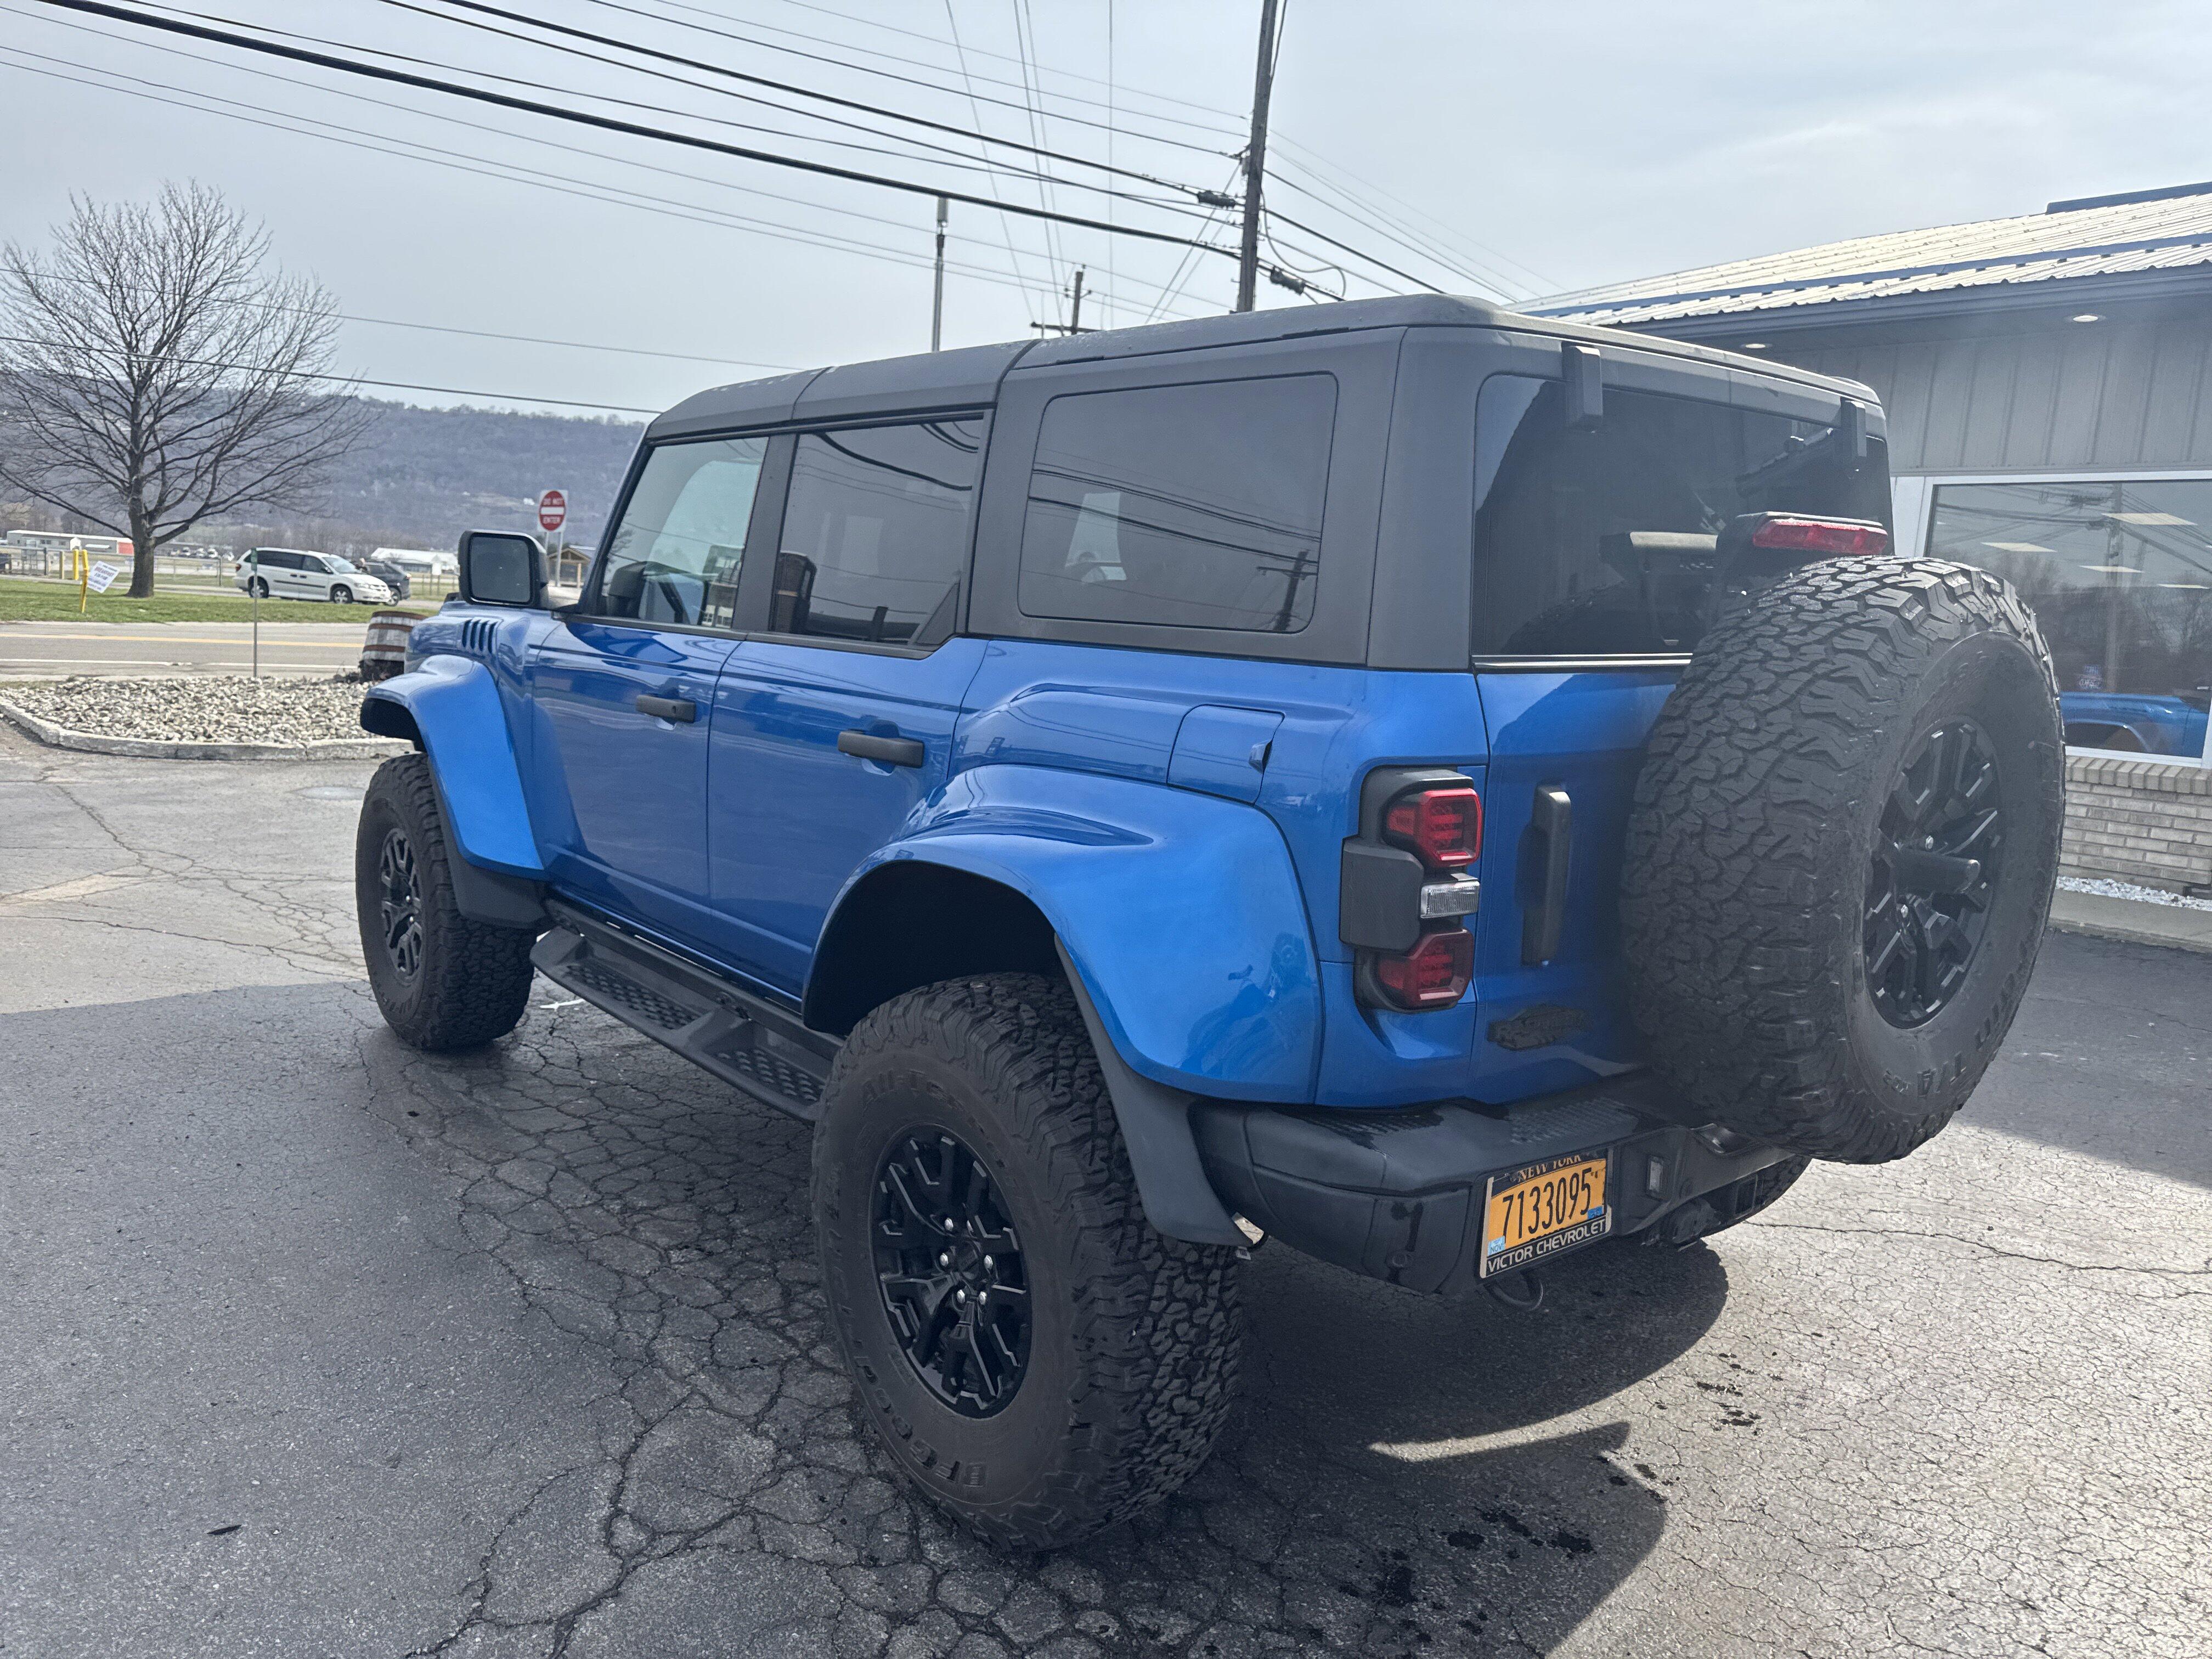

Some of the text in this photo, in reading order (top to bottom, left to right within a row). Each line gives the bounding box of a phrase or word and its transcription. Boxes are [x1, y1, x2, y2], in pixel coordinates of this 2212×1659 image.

[543, 497, 563, 505] DO NOT
[1502, 1167, 1592, 1244] 7133095
[1487, 1218, 1605, 1273] VICTOR CHEVROLET
